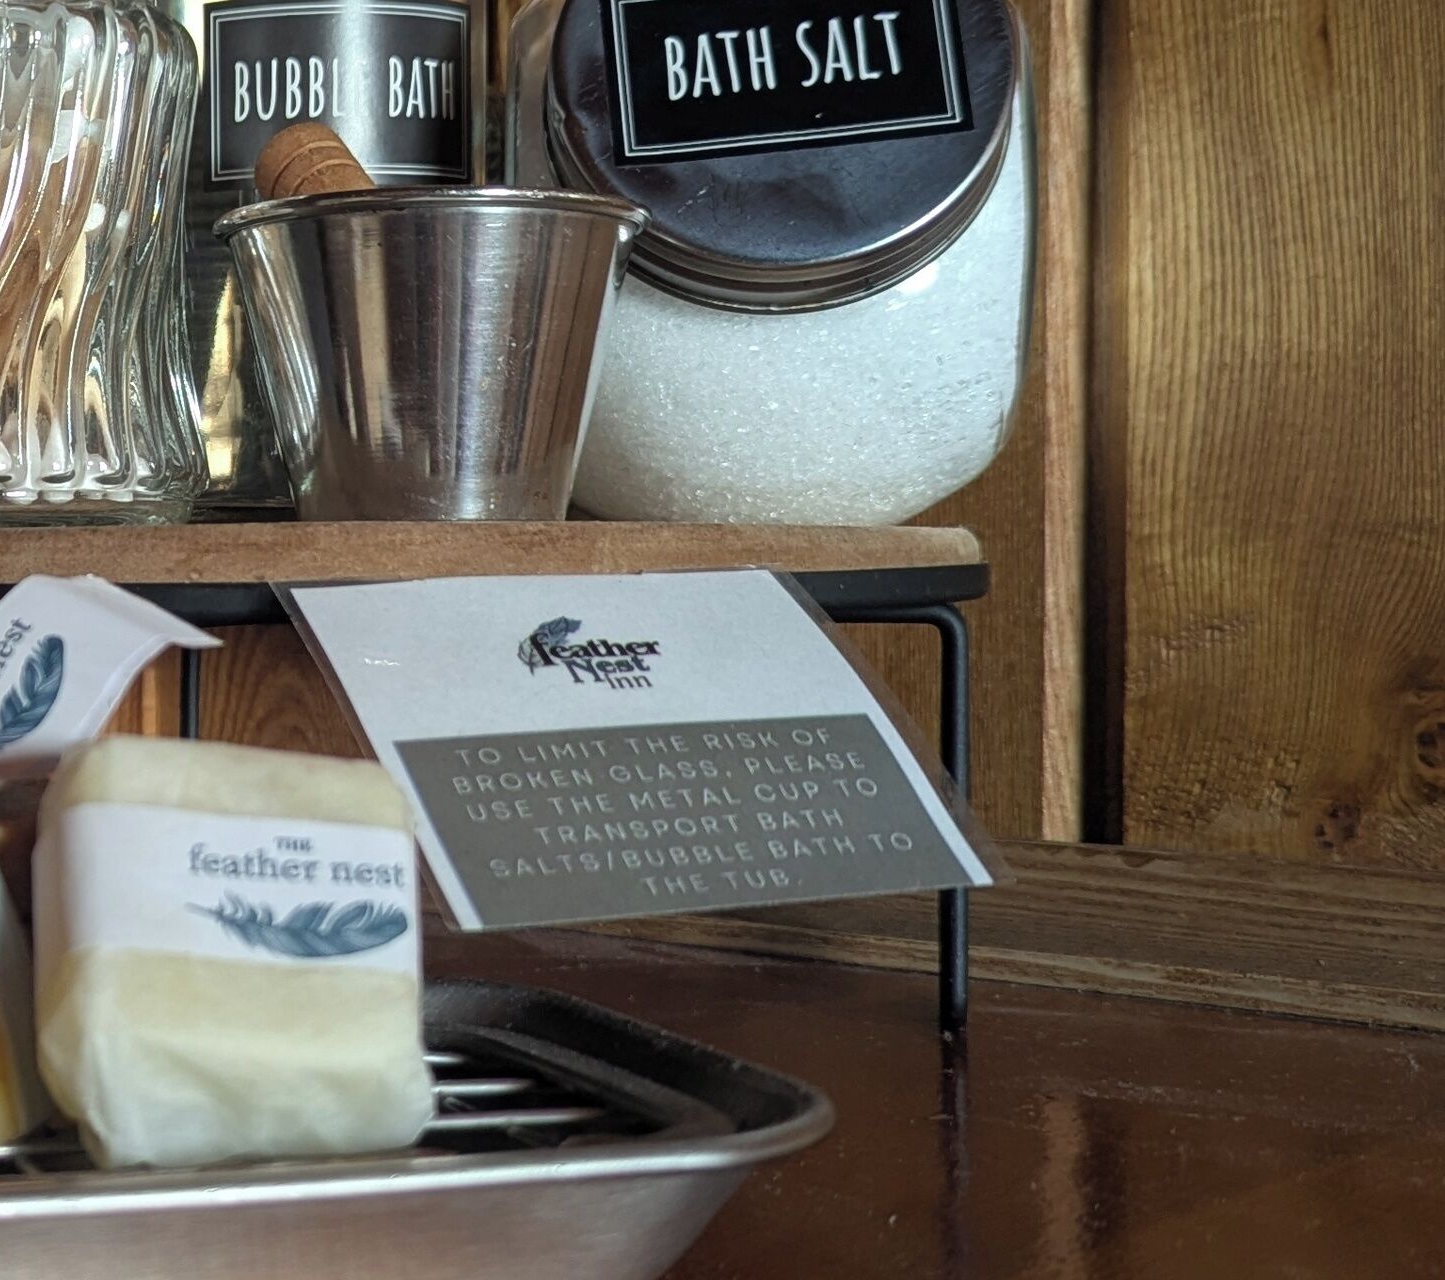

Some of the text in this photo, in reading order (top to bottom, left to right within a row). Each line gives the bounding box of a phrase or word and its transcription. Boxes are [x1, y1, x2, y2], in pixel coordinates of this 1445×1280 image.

[664, 11, 902, 101] BATH SALT
[388, 55, 455, 120] BATH
[561, 655, 651, 684] Nest
[455, 727, 831, 767] TO LIMIT THE RISK OF
[452, 768, 594, 795] BROKEN
[743, 751, 866, 775] PLEASE
[466, 777, 879, 822] USE THE METAL CUP TO
[534, 808, 844, 846] TRANSPORT BATH
[188, 841, 406, 888] feather nest
[489, 832, 914, 878] SALTS/BUBBLE BATH TO
[641, 868, 803, 896] THE TUB.
